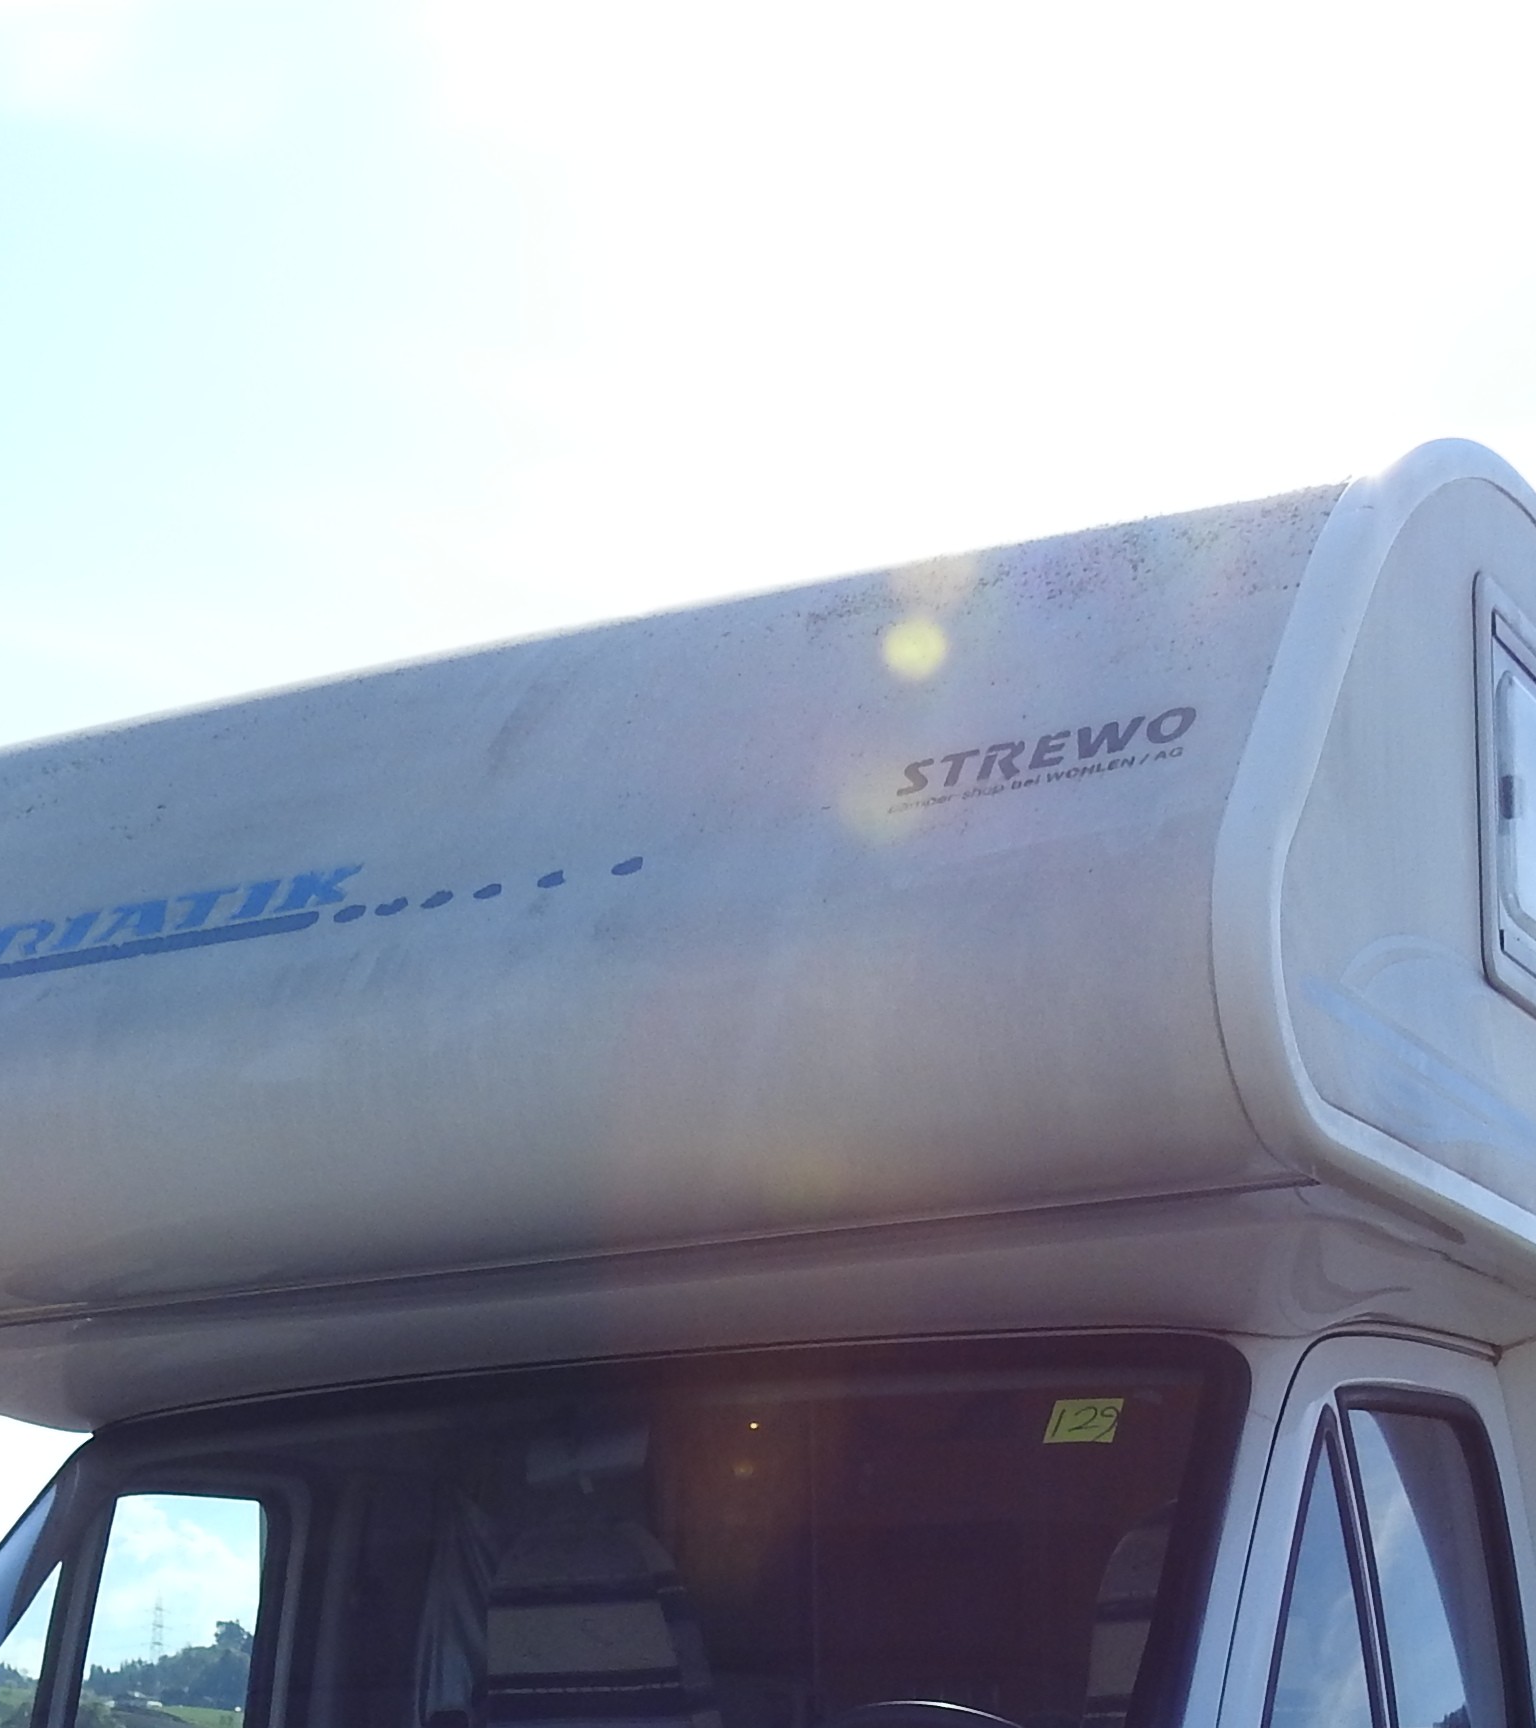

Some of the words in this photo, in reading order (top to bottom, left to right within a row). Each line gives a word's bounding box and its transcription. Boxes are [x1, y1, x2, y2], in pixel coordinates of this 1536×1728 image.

[896, 706, 1198, 797] STREWO
[960, 784, 1005, 801] shop
[1046, 755, 1136, 783] WOHLEN
[1153, 746, 1184, 761] AG
[1050, 1405, 1120, 1442] 129
